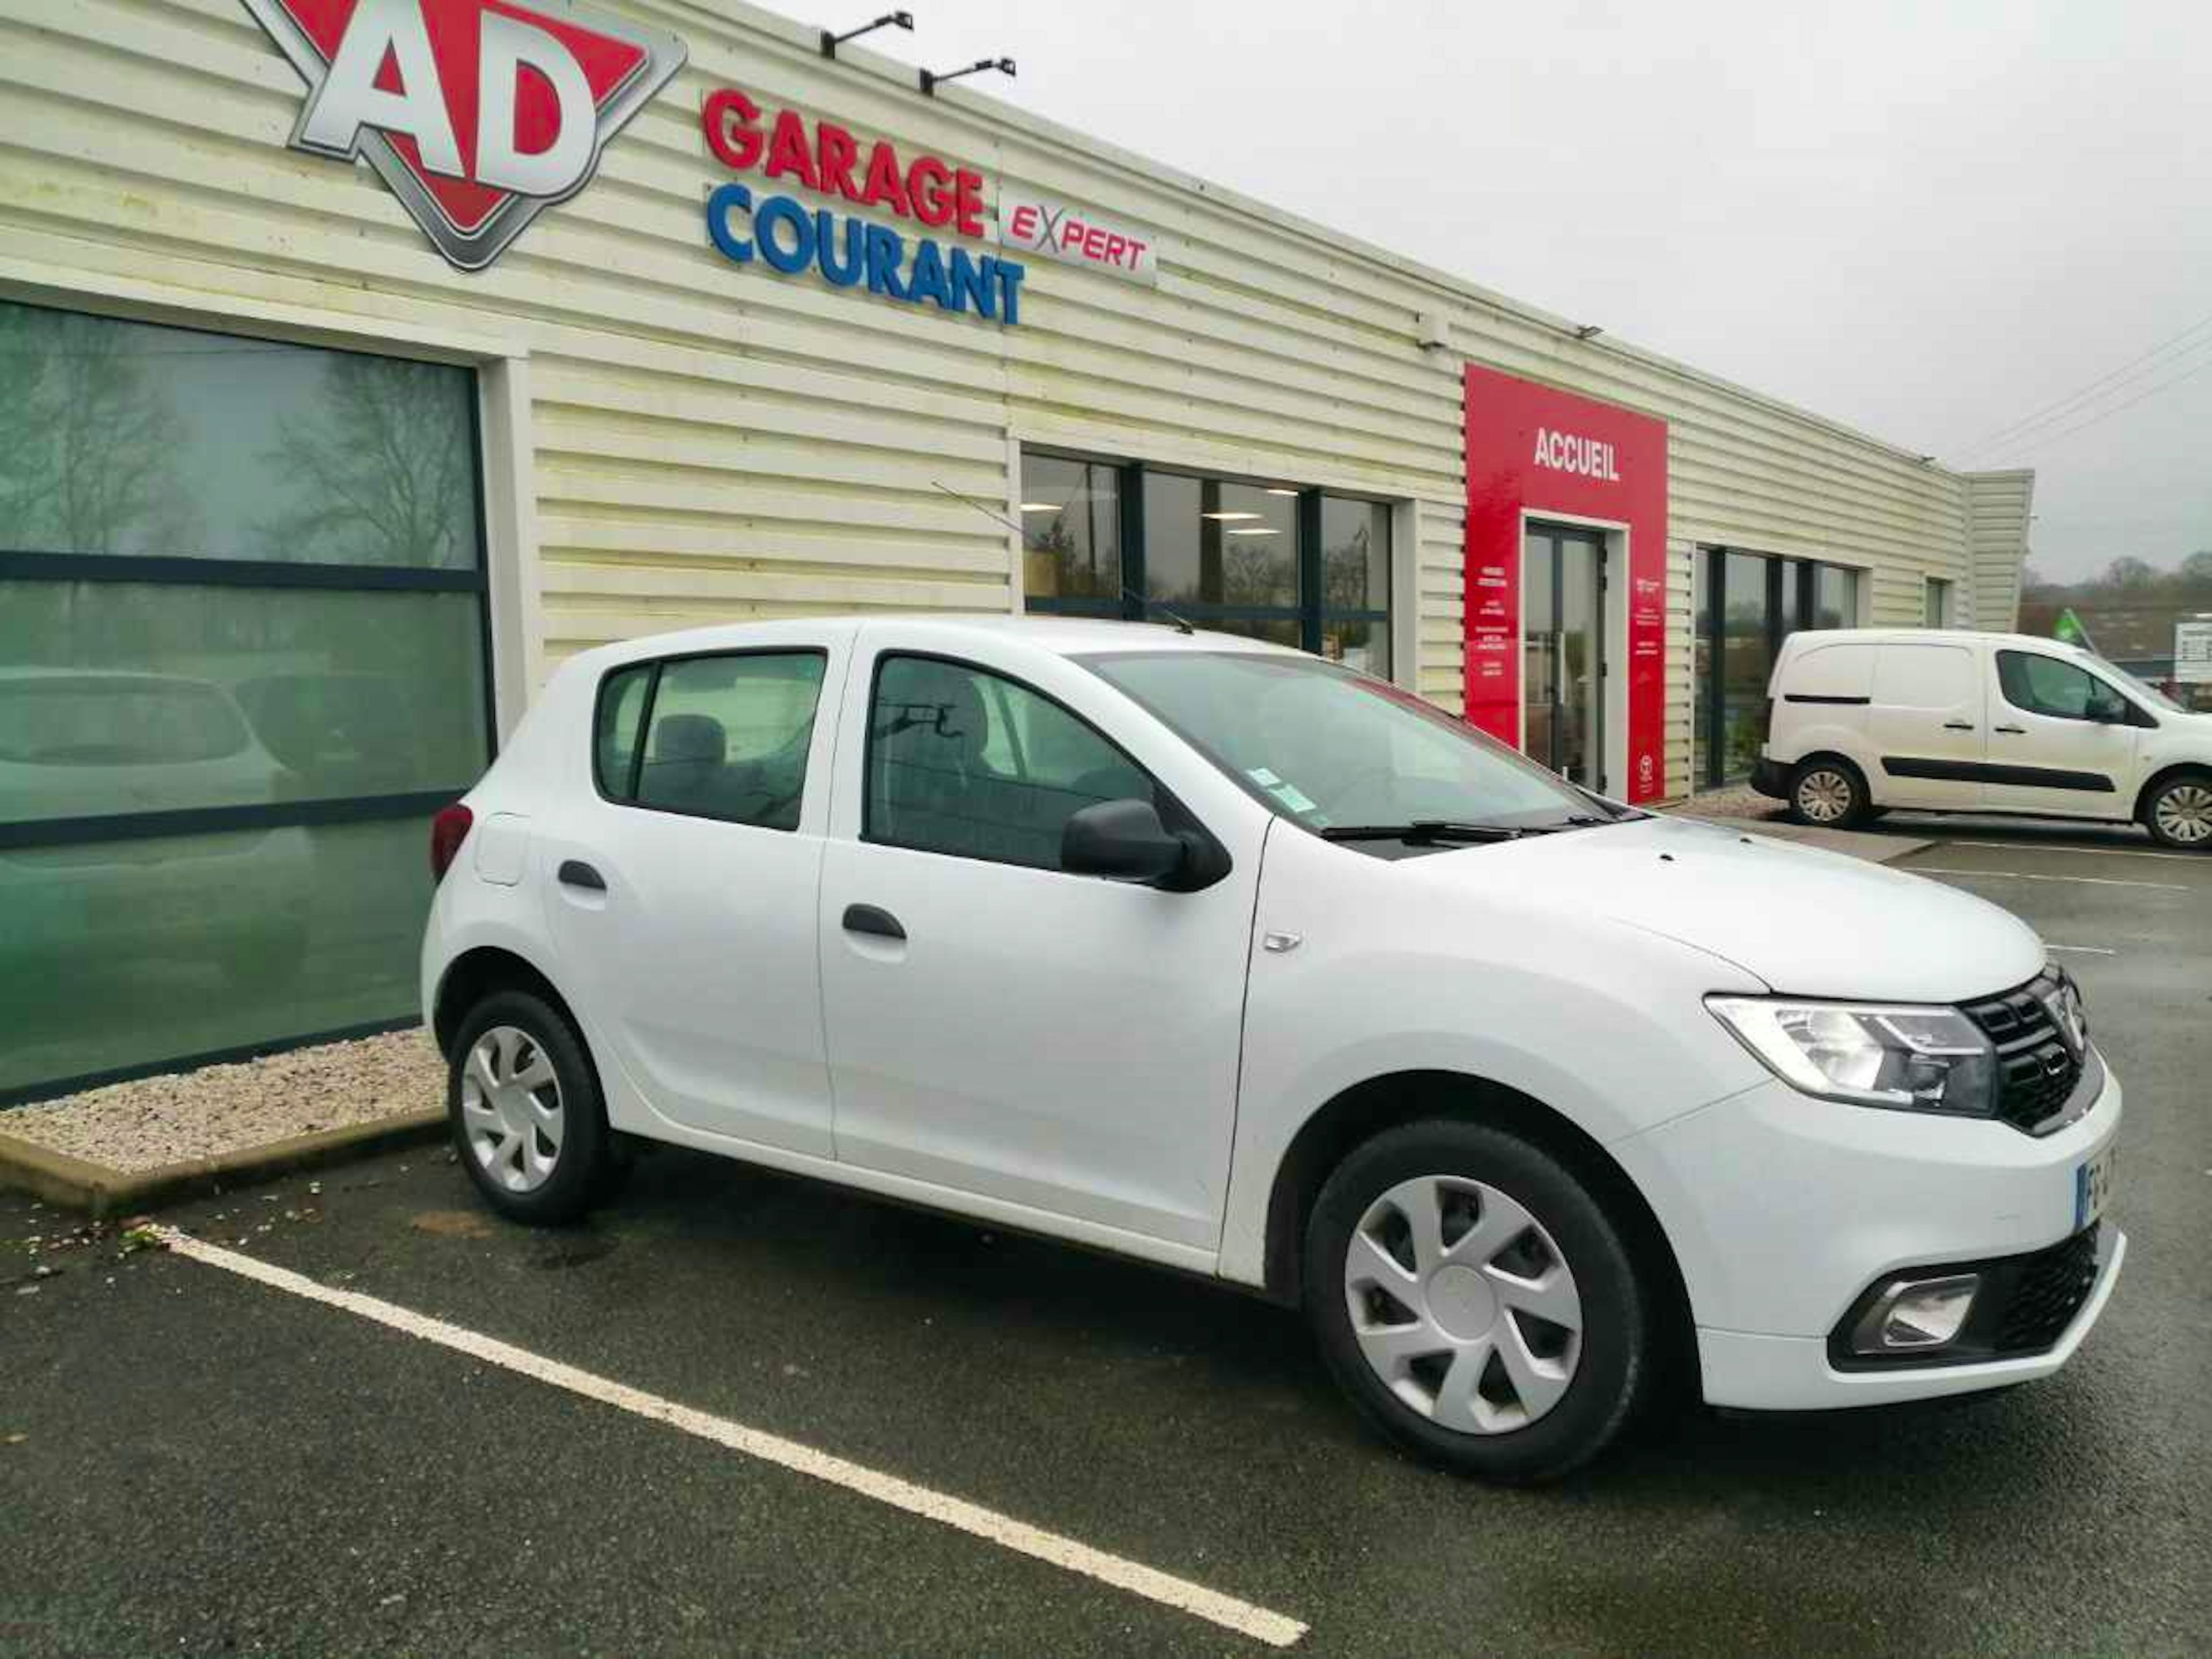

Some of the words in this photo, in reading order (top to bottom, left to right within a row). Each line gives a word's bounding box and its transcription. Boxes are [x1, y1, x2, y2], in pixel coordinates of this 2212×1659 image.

[301, 0, 597, 198] AD
[702, 88, 984, 238] GARAGE
[706, 183, 1024, 325] COURANT
[1012, 204, 1146, 271] EXPERT
[1533, 426, 1620, 482] ACCUEIL
